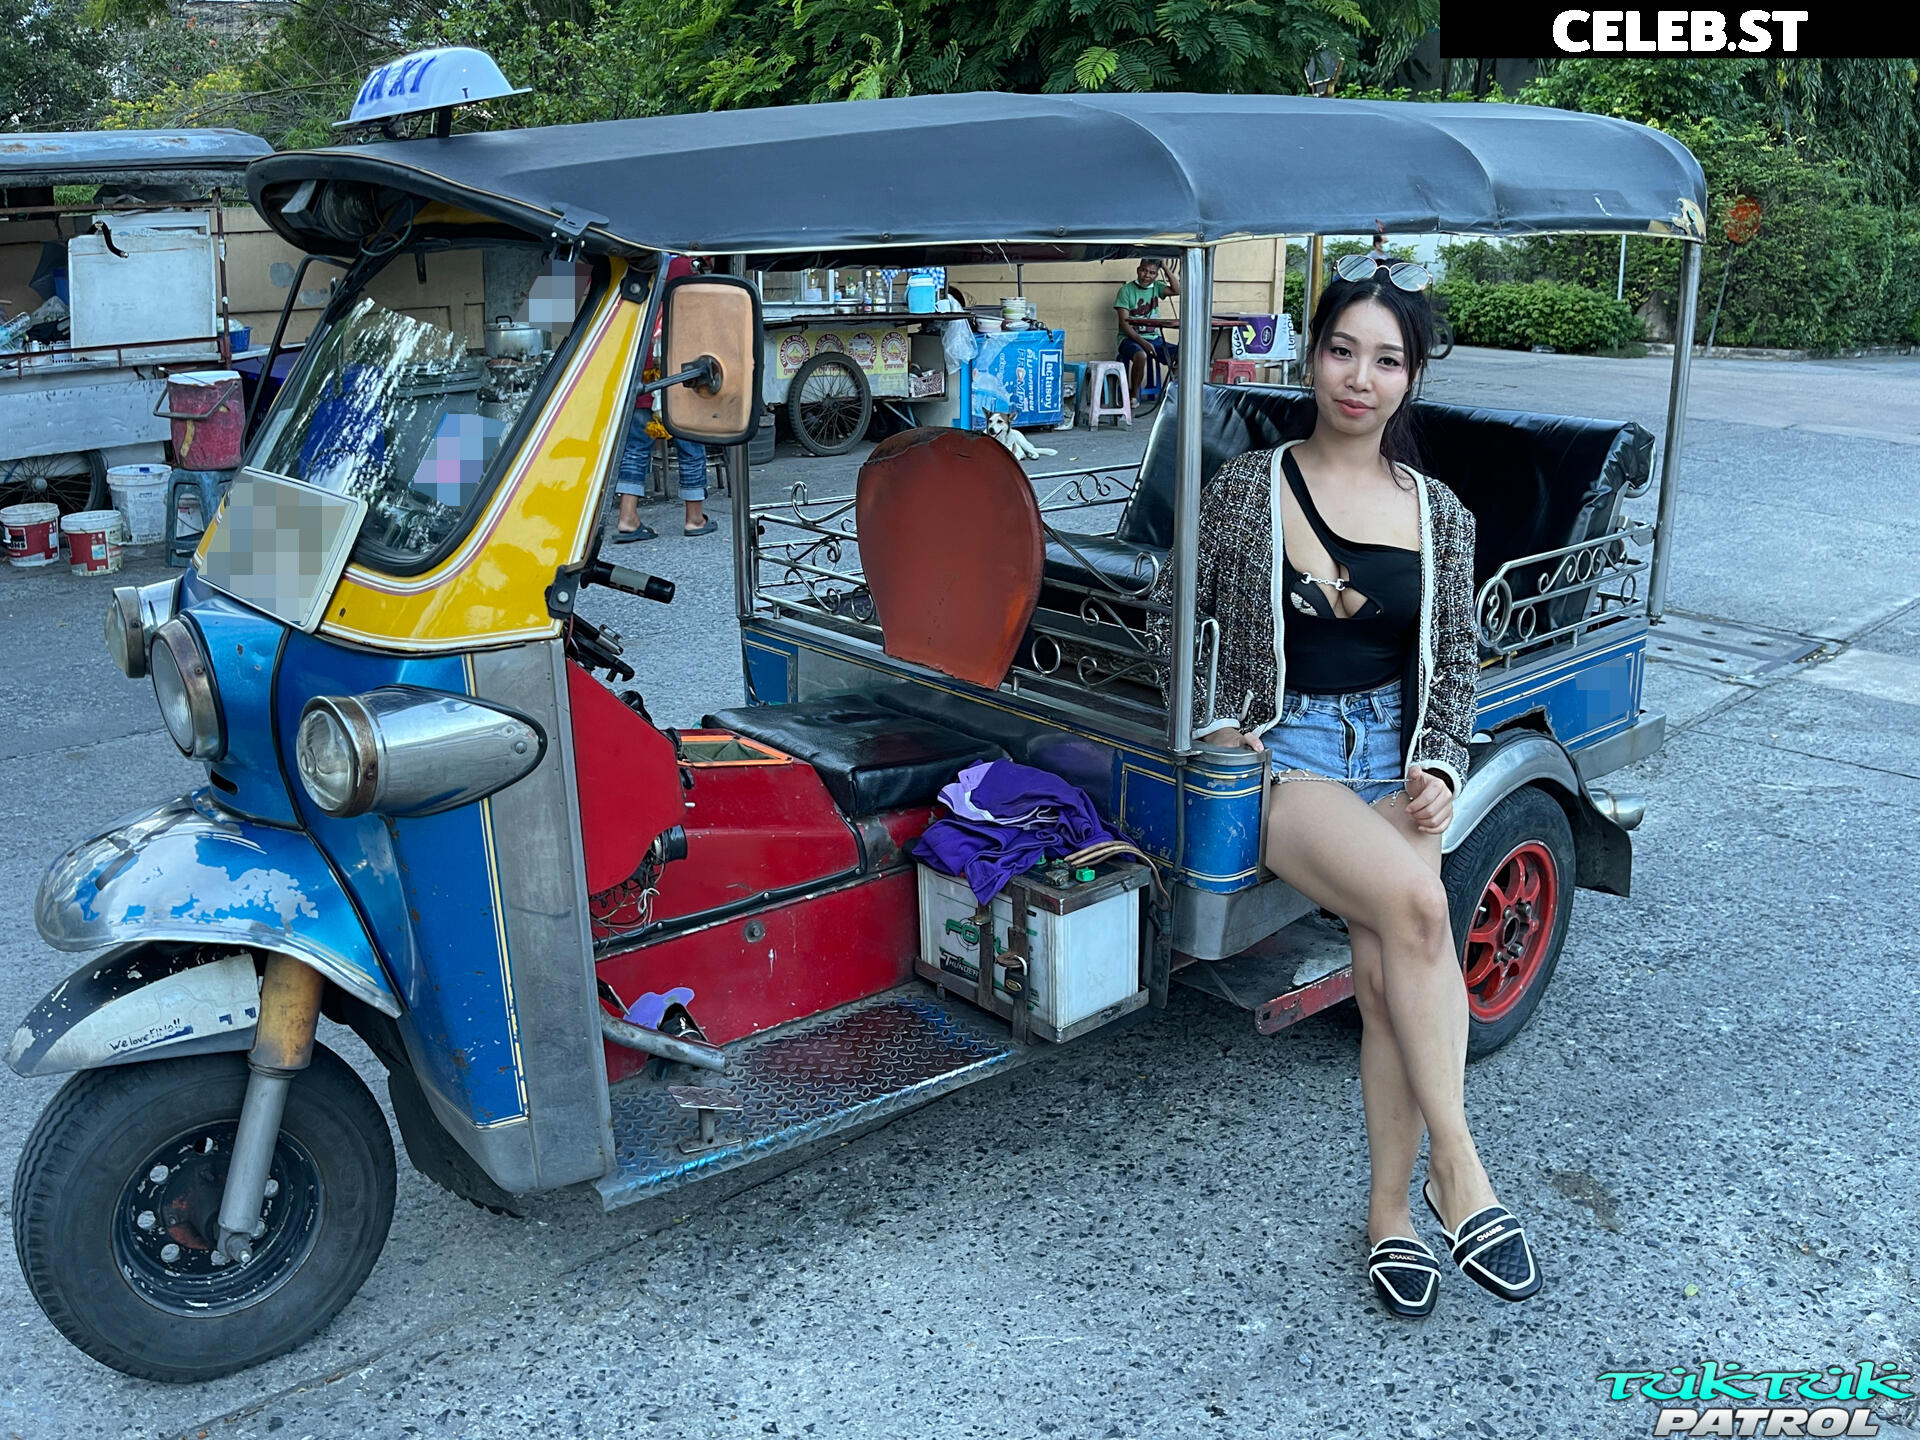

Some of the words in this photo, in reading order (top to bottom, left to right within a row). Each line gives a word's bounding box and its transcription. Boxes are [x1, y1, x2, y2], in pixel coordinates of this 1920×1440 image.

[1041, 353, 1059, 409] Lactasoy
[940, 951, 979, 977] THUNDER
[129, 1034, 149, 1046] love
